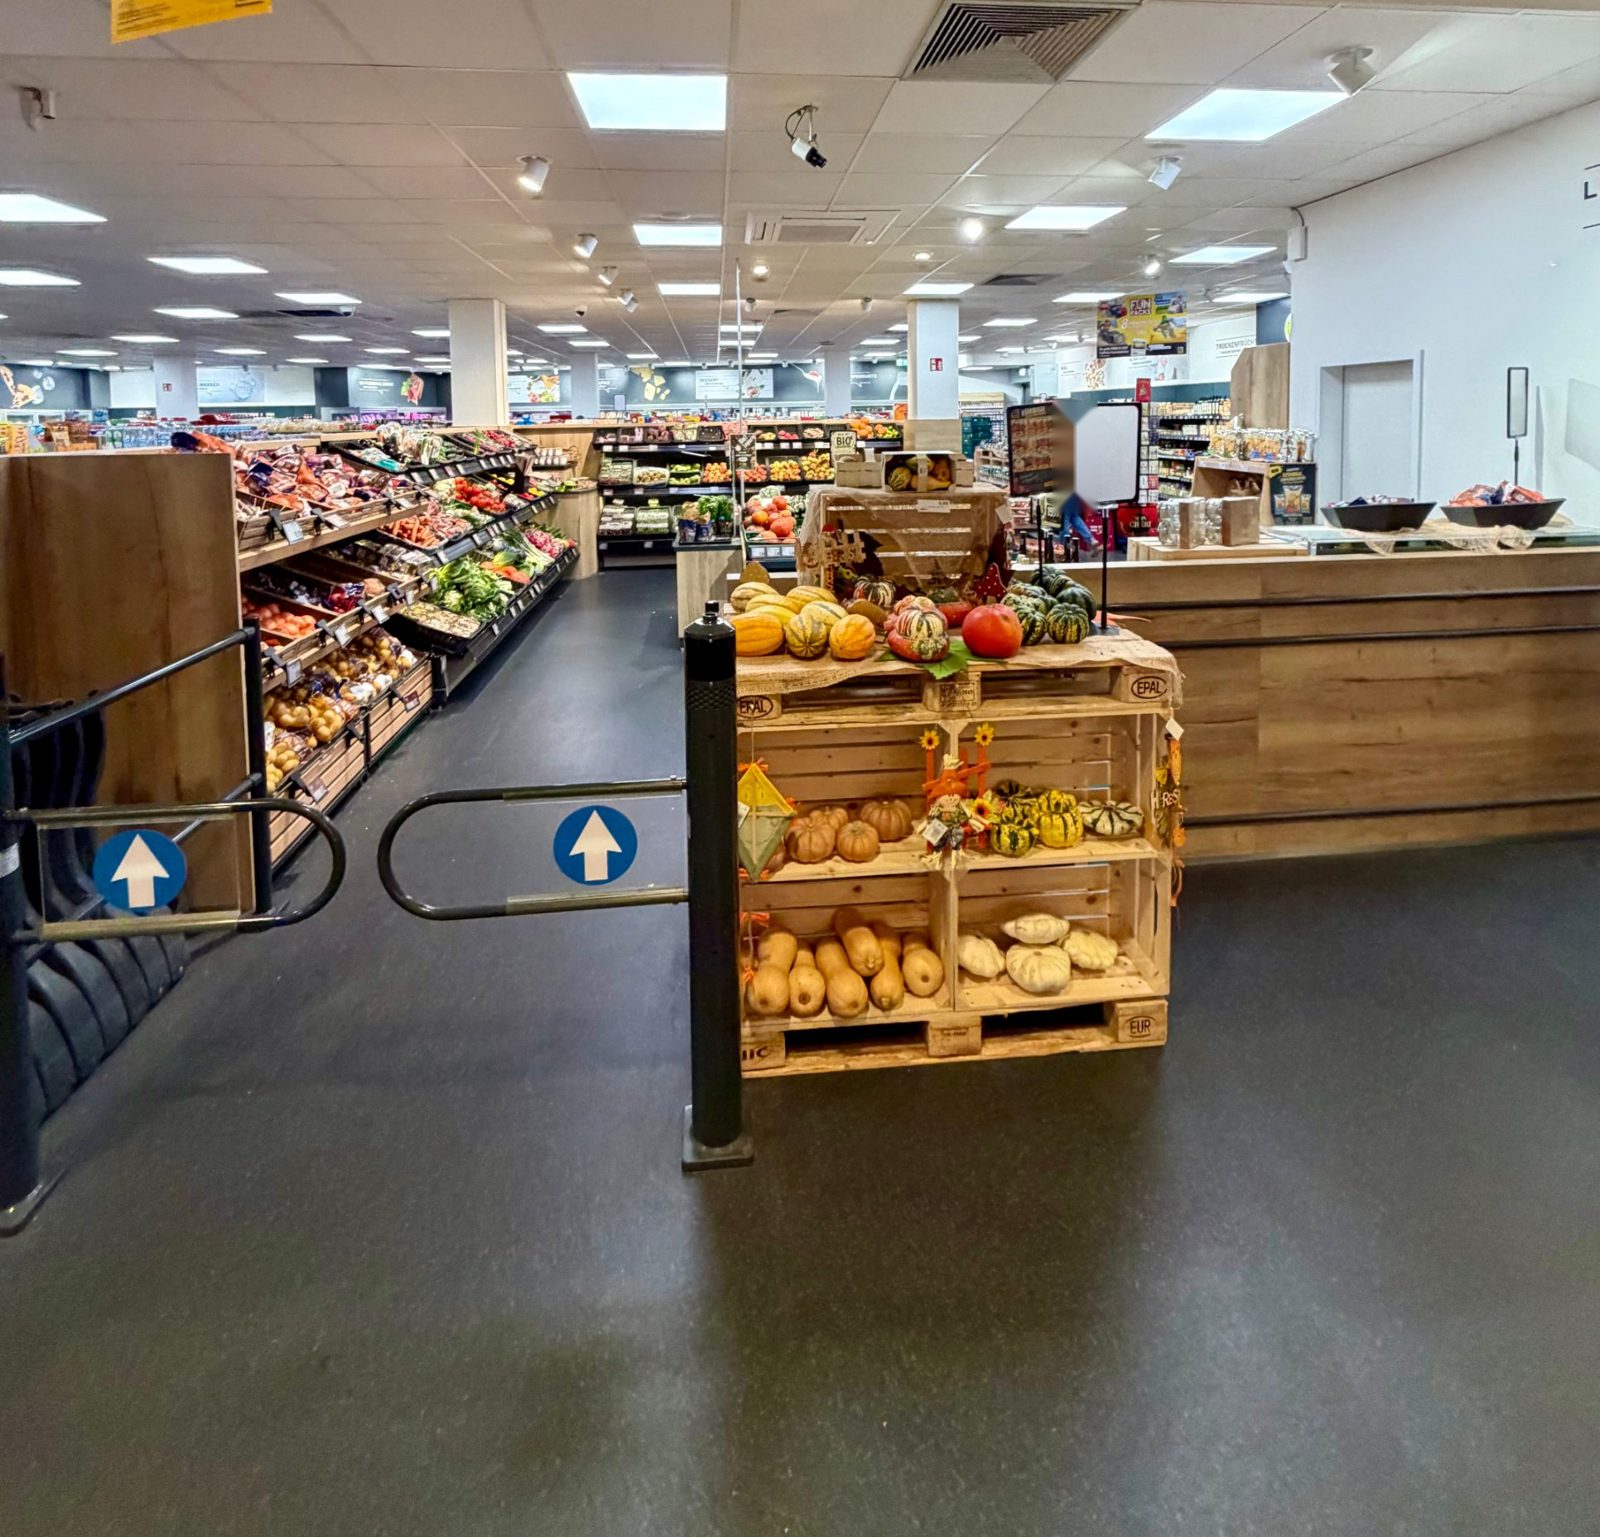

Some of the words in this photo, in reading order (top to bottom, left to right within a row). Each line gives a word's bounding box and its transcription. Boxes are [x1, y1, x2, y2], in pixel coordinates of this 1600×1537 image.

[1584, 181, 1597, 200] L
[1137, 681, 1161, 694] EPAL
[740, 699, 767, 713] EPAL
[1130, 1019, 1151, 1034] EUR
